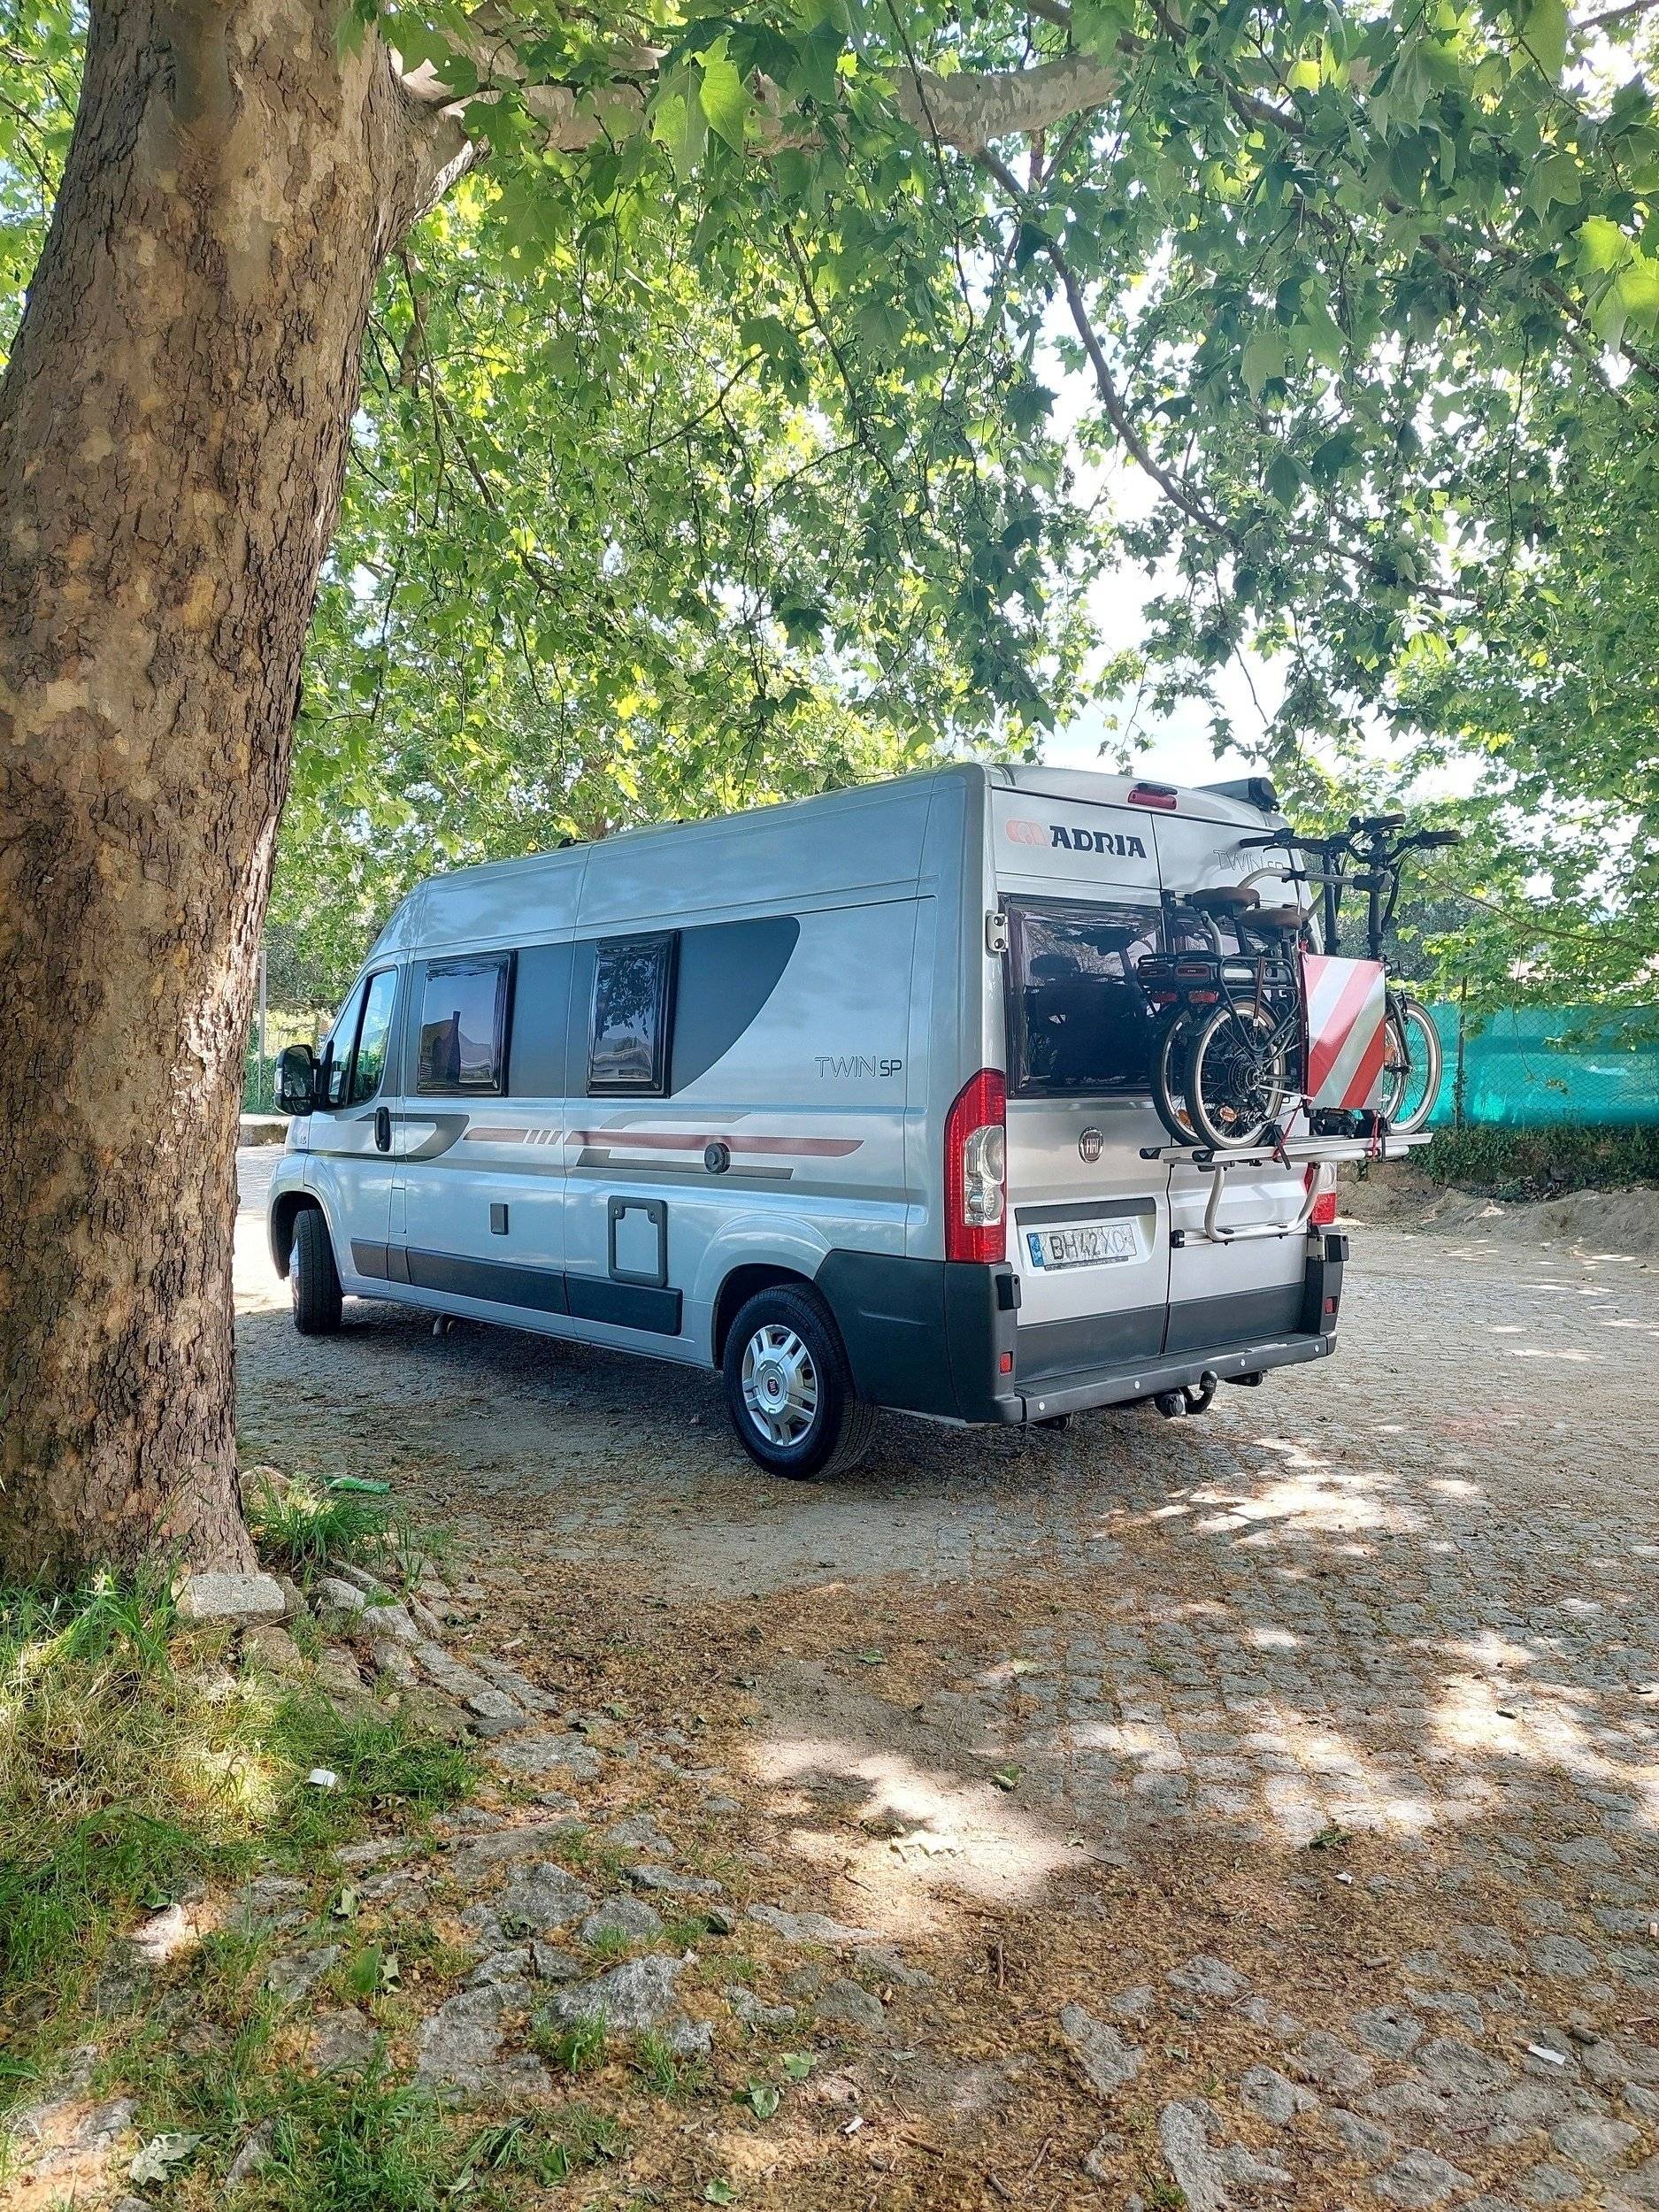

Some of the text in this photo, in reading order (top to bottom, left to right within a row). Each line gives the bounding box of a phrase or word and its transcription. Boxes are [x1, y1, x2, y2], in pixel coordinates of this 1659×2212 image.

[1049, 825, 1147, 859] ADRIA
[1213, 849, 1263, 872] TWIN
[814, 1056, 902, 1078] TWIN SP
